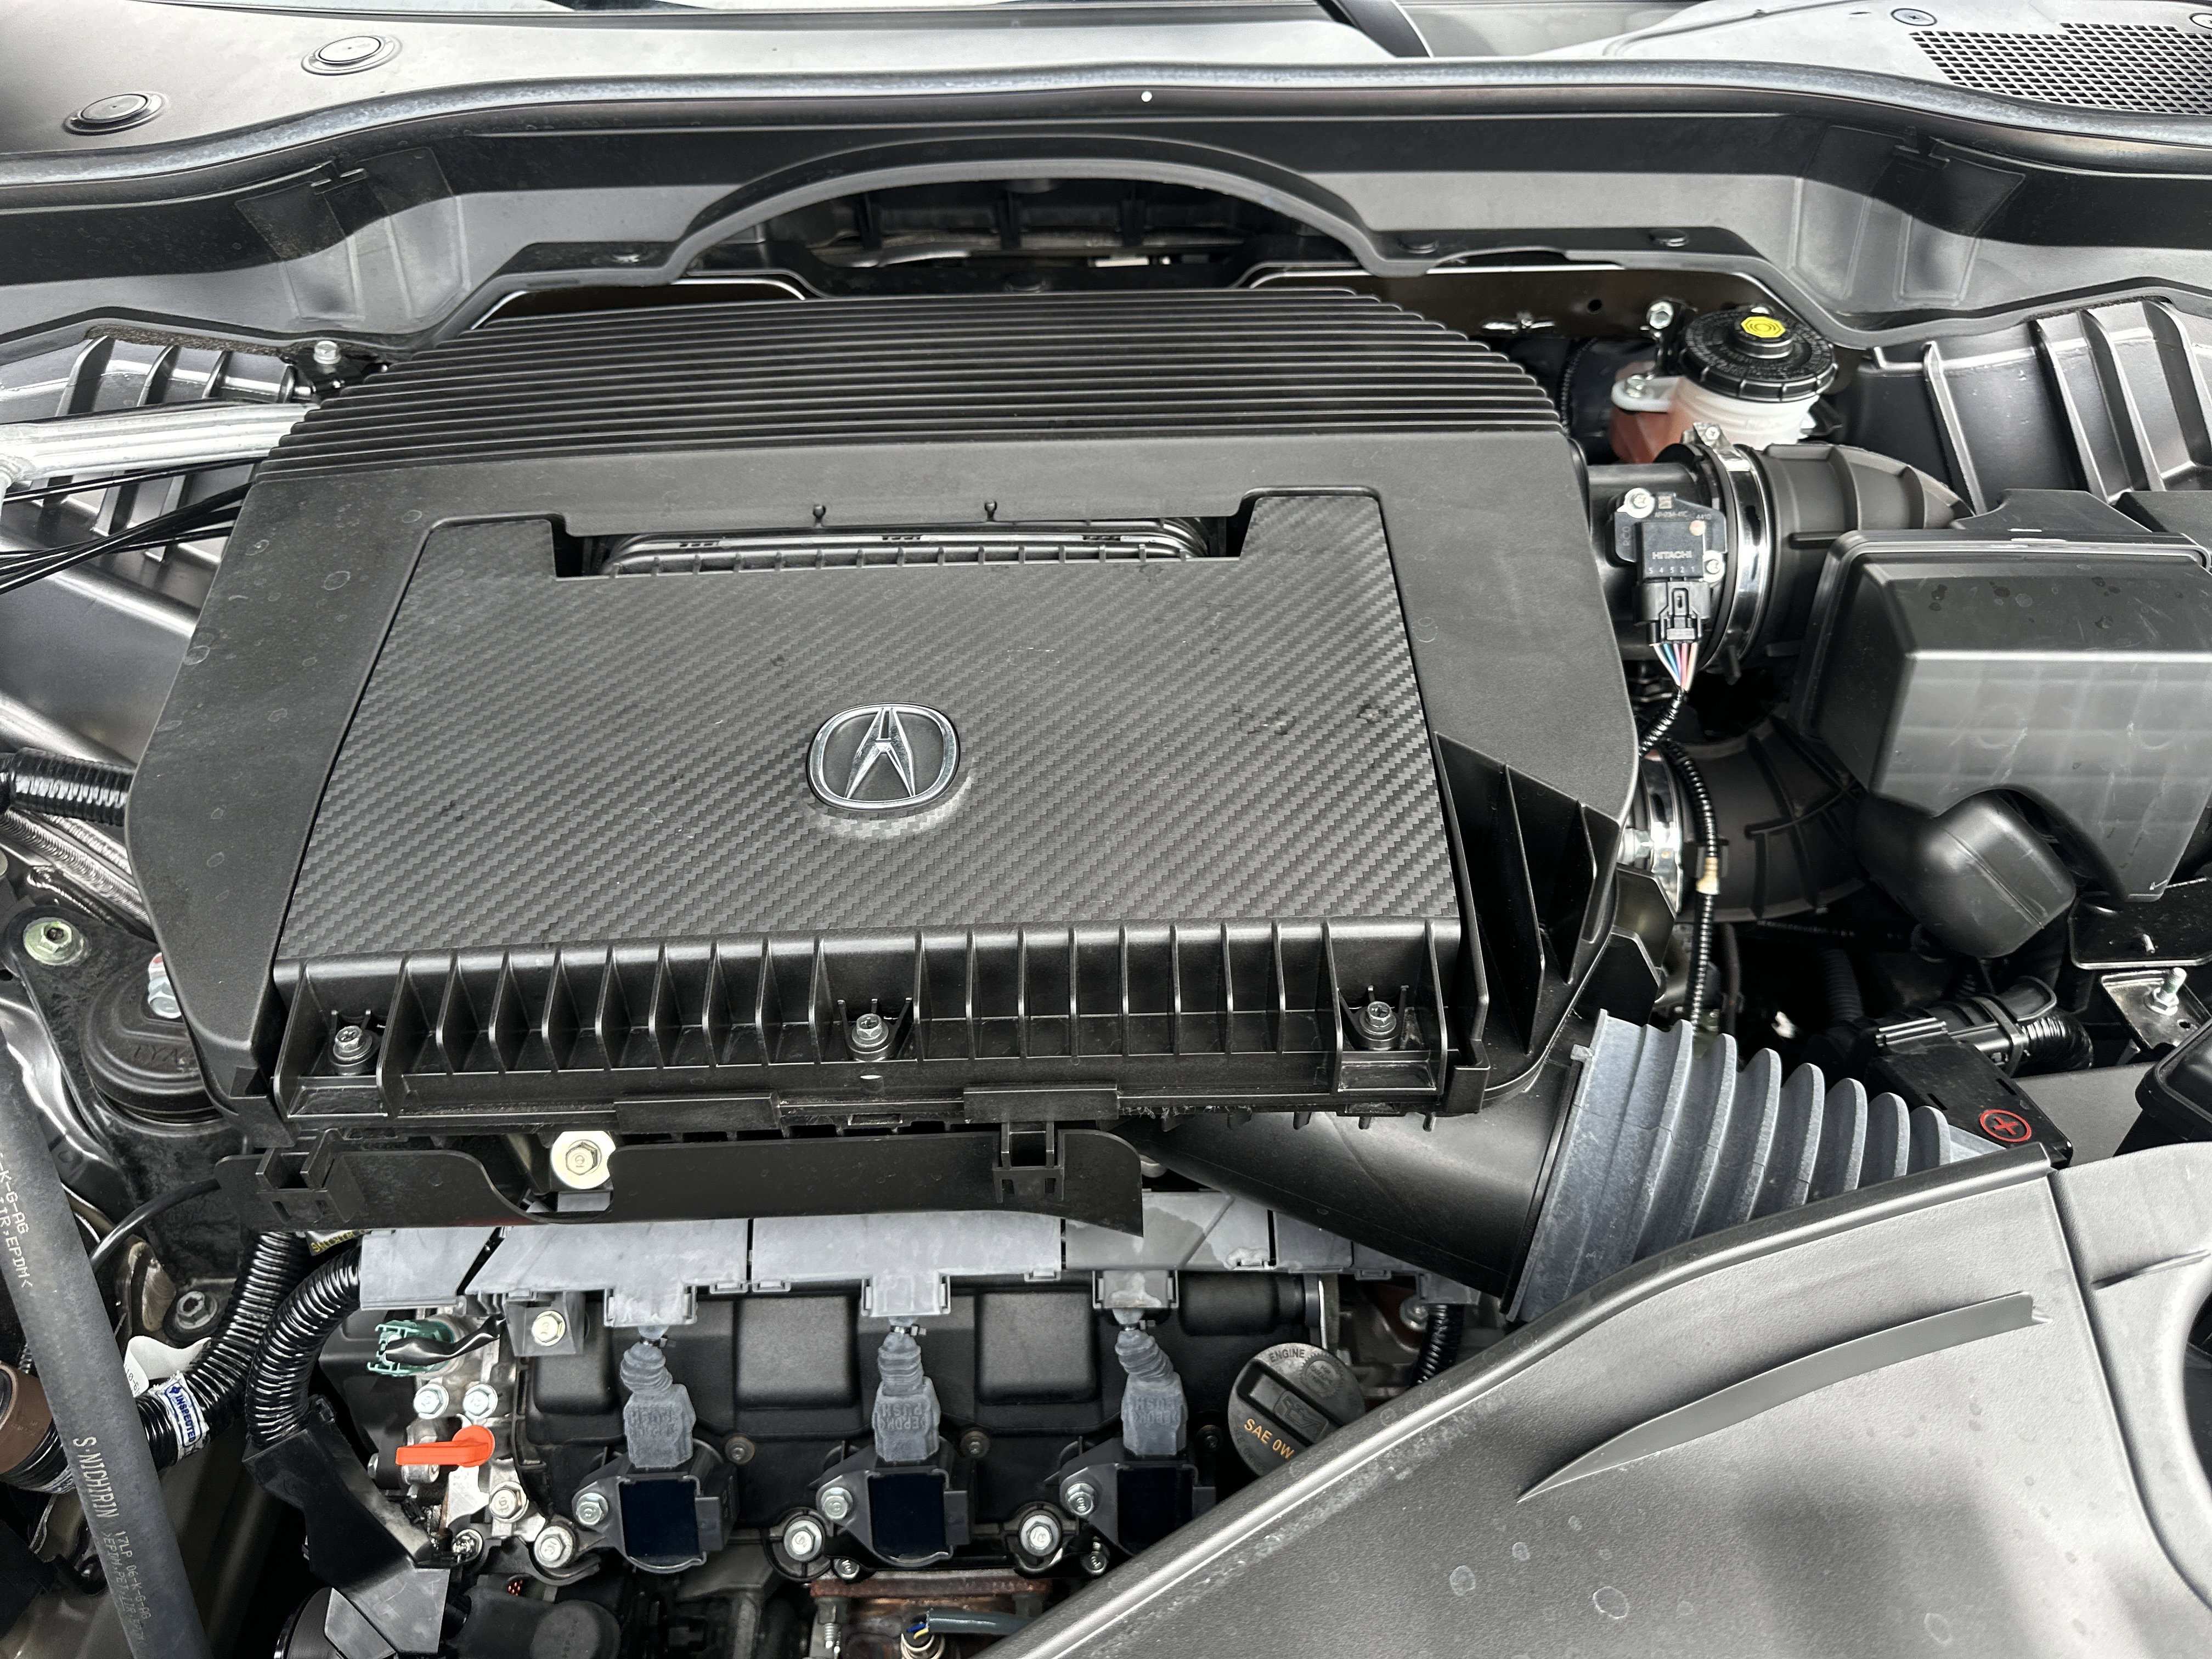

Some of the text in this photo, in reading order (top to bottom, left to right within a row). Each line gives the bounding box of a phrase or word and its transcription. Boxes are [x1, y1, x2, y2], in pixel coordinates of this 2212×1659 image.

[1651, 550, 1692, 560] HITACHI
[1268, 1347, 1306, 1363] ENGINE
[882, 1402, 922, 1417] PUSH
[175, 1393, 196, 1443] INSPECTED
[1243, 1417, 1273, 1446] SAE
